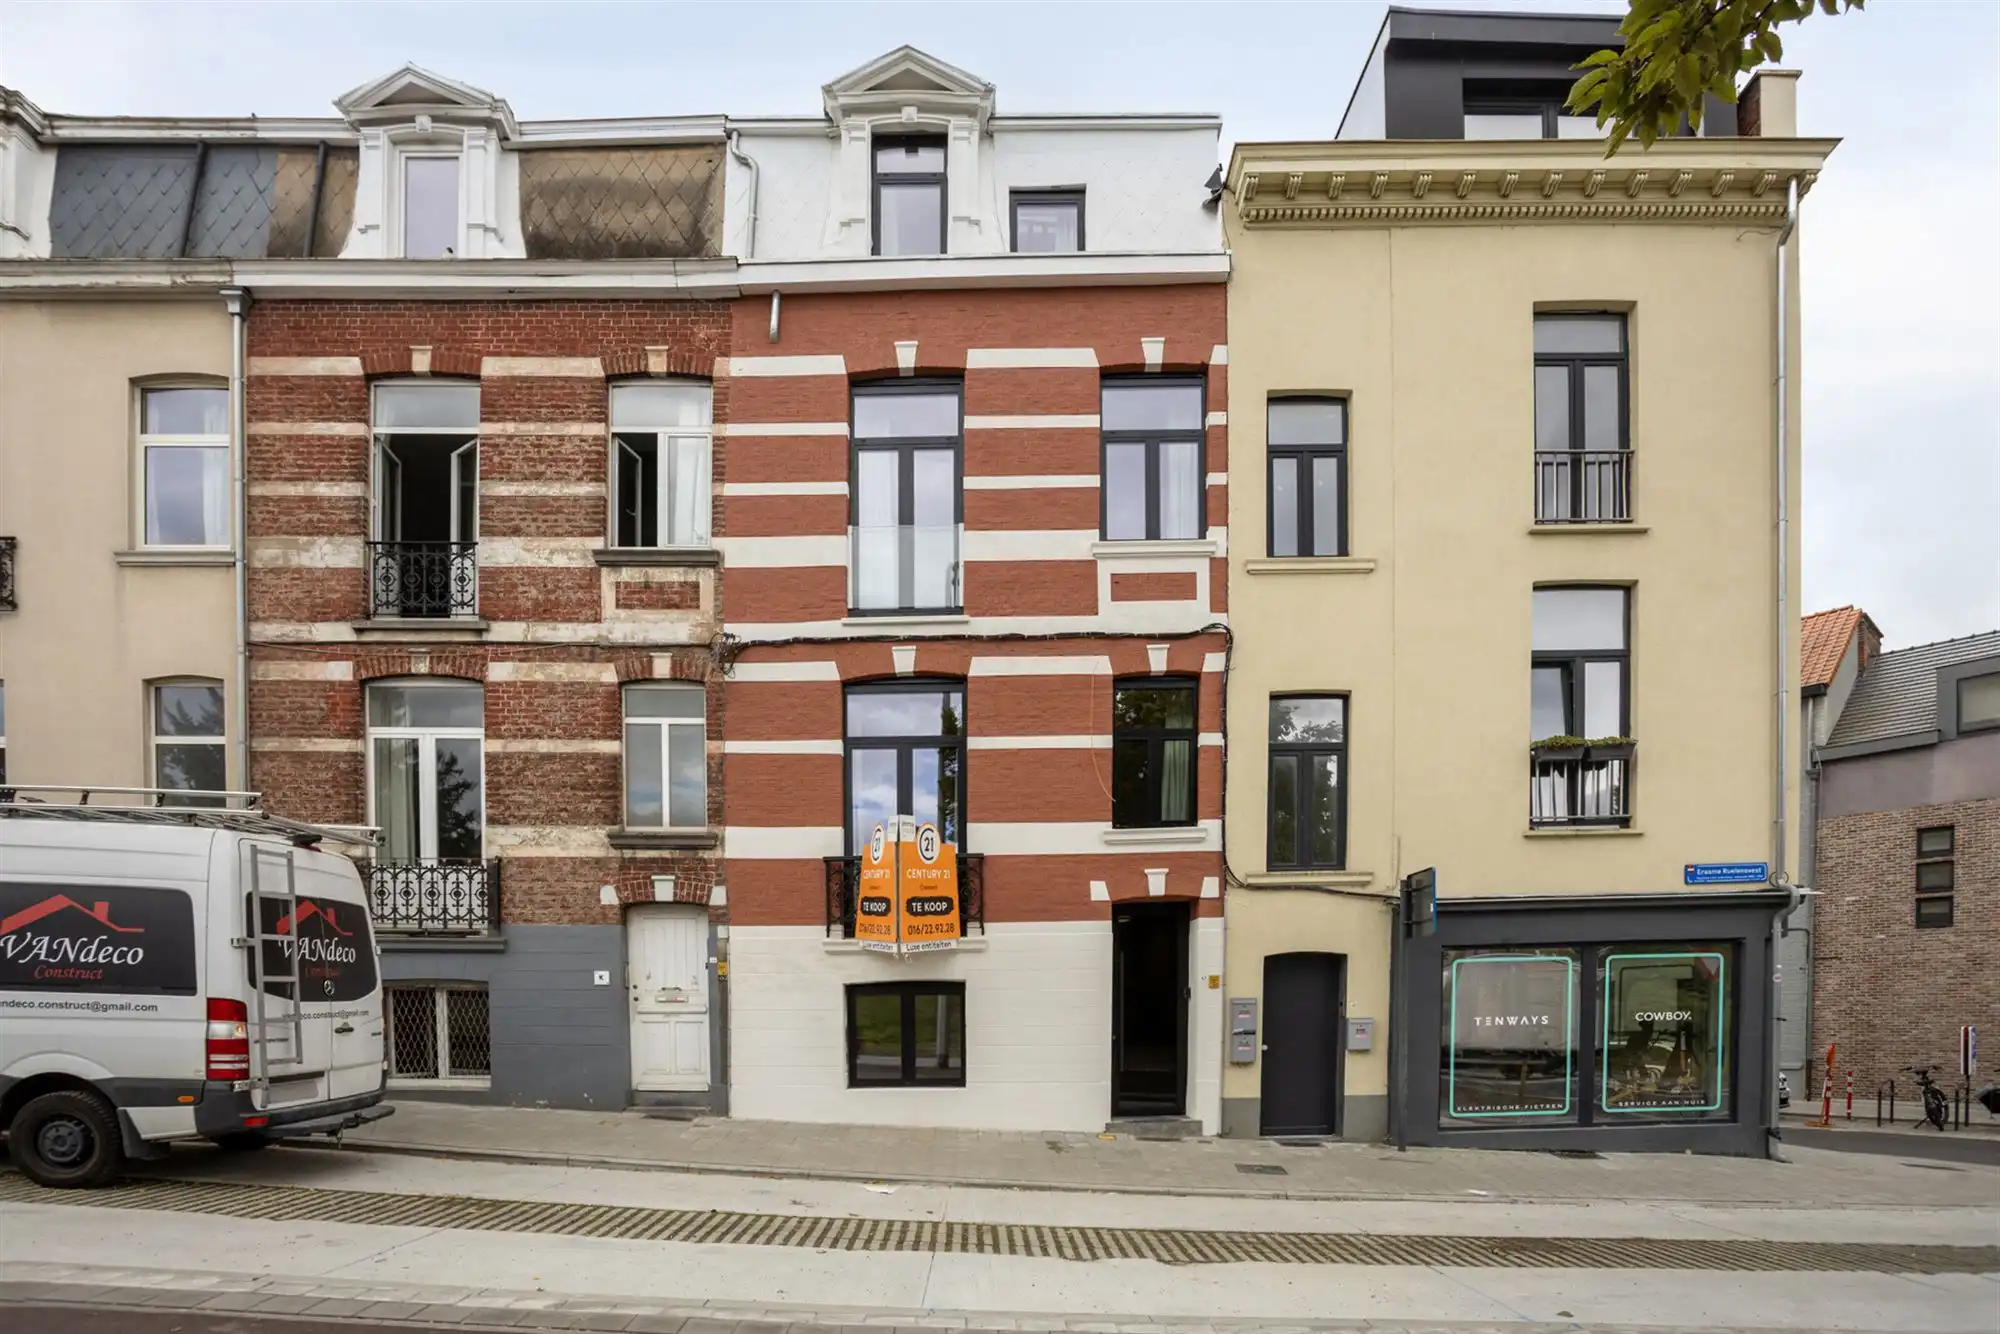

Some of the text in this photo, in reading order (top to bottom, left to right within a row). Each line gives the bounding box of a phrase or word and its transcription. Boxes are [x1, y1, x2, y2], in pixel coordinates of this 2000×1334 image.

[906, 869, 951, 879] CENTURY 21
[863, 902, 887, 912] TE KOOP
[912, 902, 948, 912] TE KOOP
[34, 964, 104, 979] Construct
[0, 999, 158, 1013] ndeco.construct@gmail.com
[1474, 1015, 1549, 1026] TENWAYS
